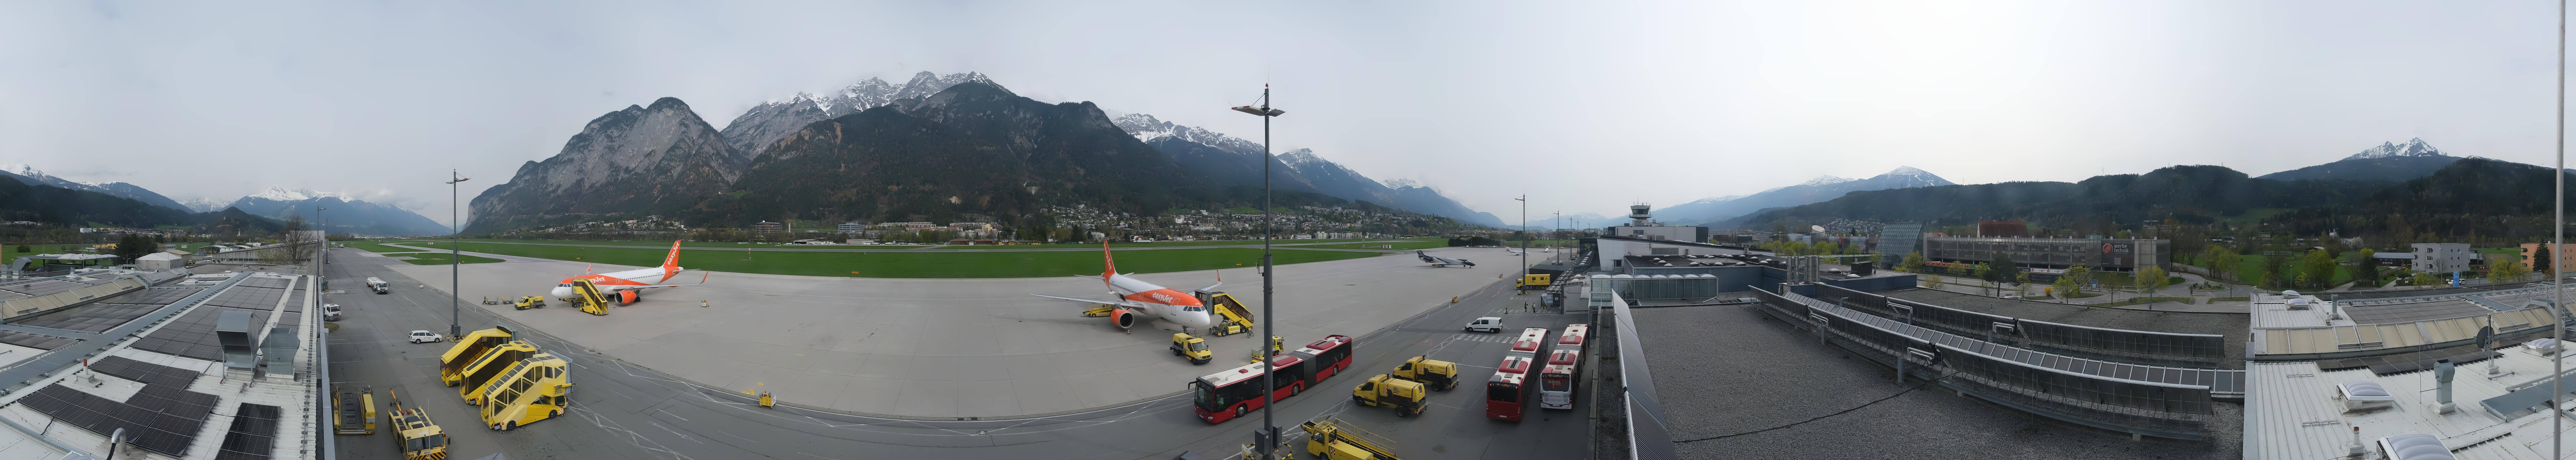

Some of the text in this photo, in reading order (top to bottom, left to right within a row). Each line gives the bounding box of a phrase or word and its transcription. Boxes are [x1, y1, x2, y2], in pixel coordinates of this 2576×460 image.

[668, 242, 680, 265] easyJet
[1153, 292, 1173, 303] easyJet
[488, 370, 505, 383] www.innsbruck-airport.com
[516, 387, 535, 403] www.innsbruck-airport.com
